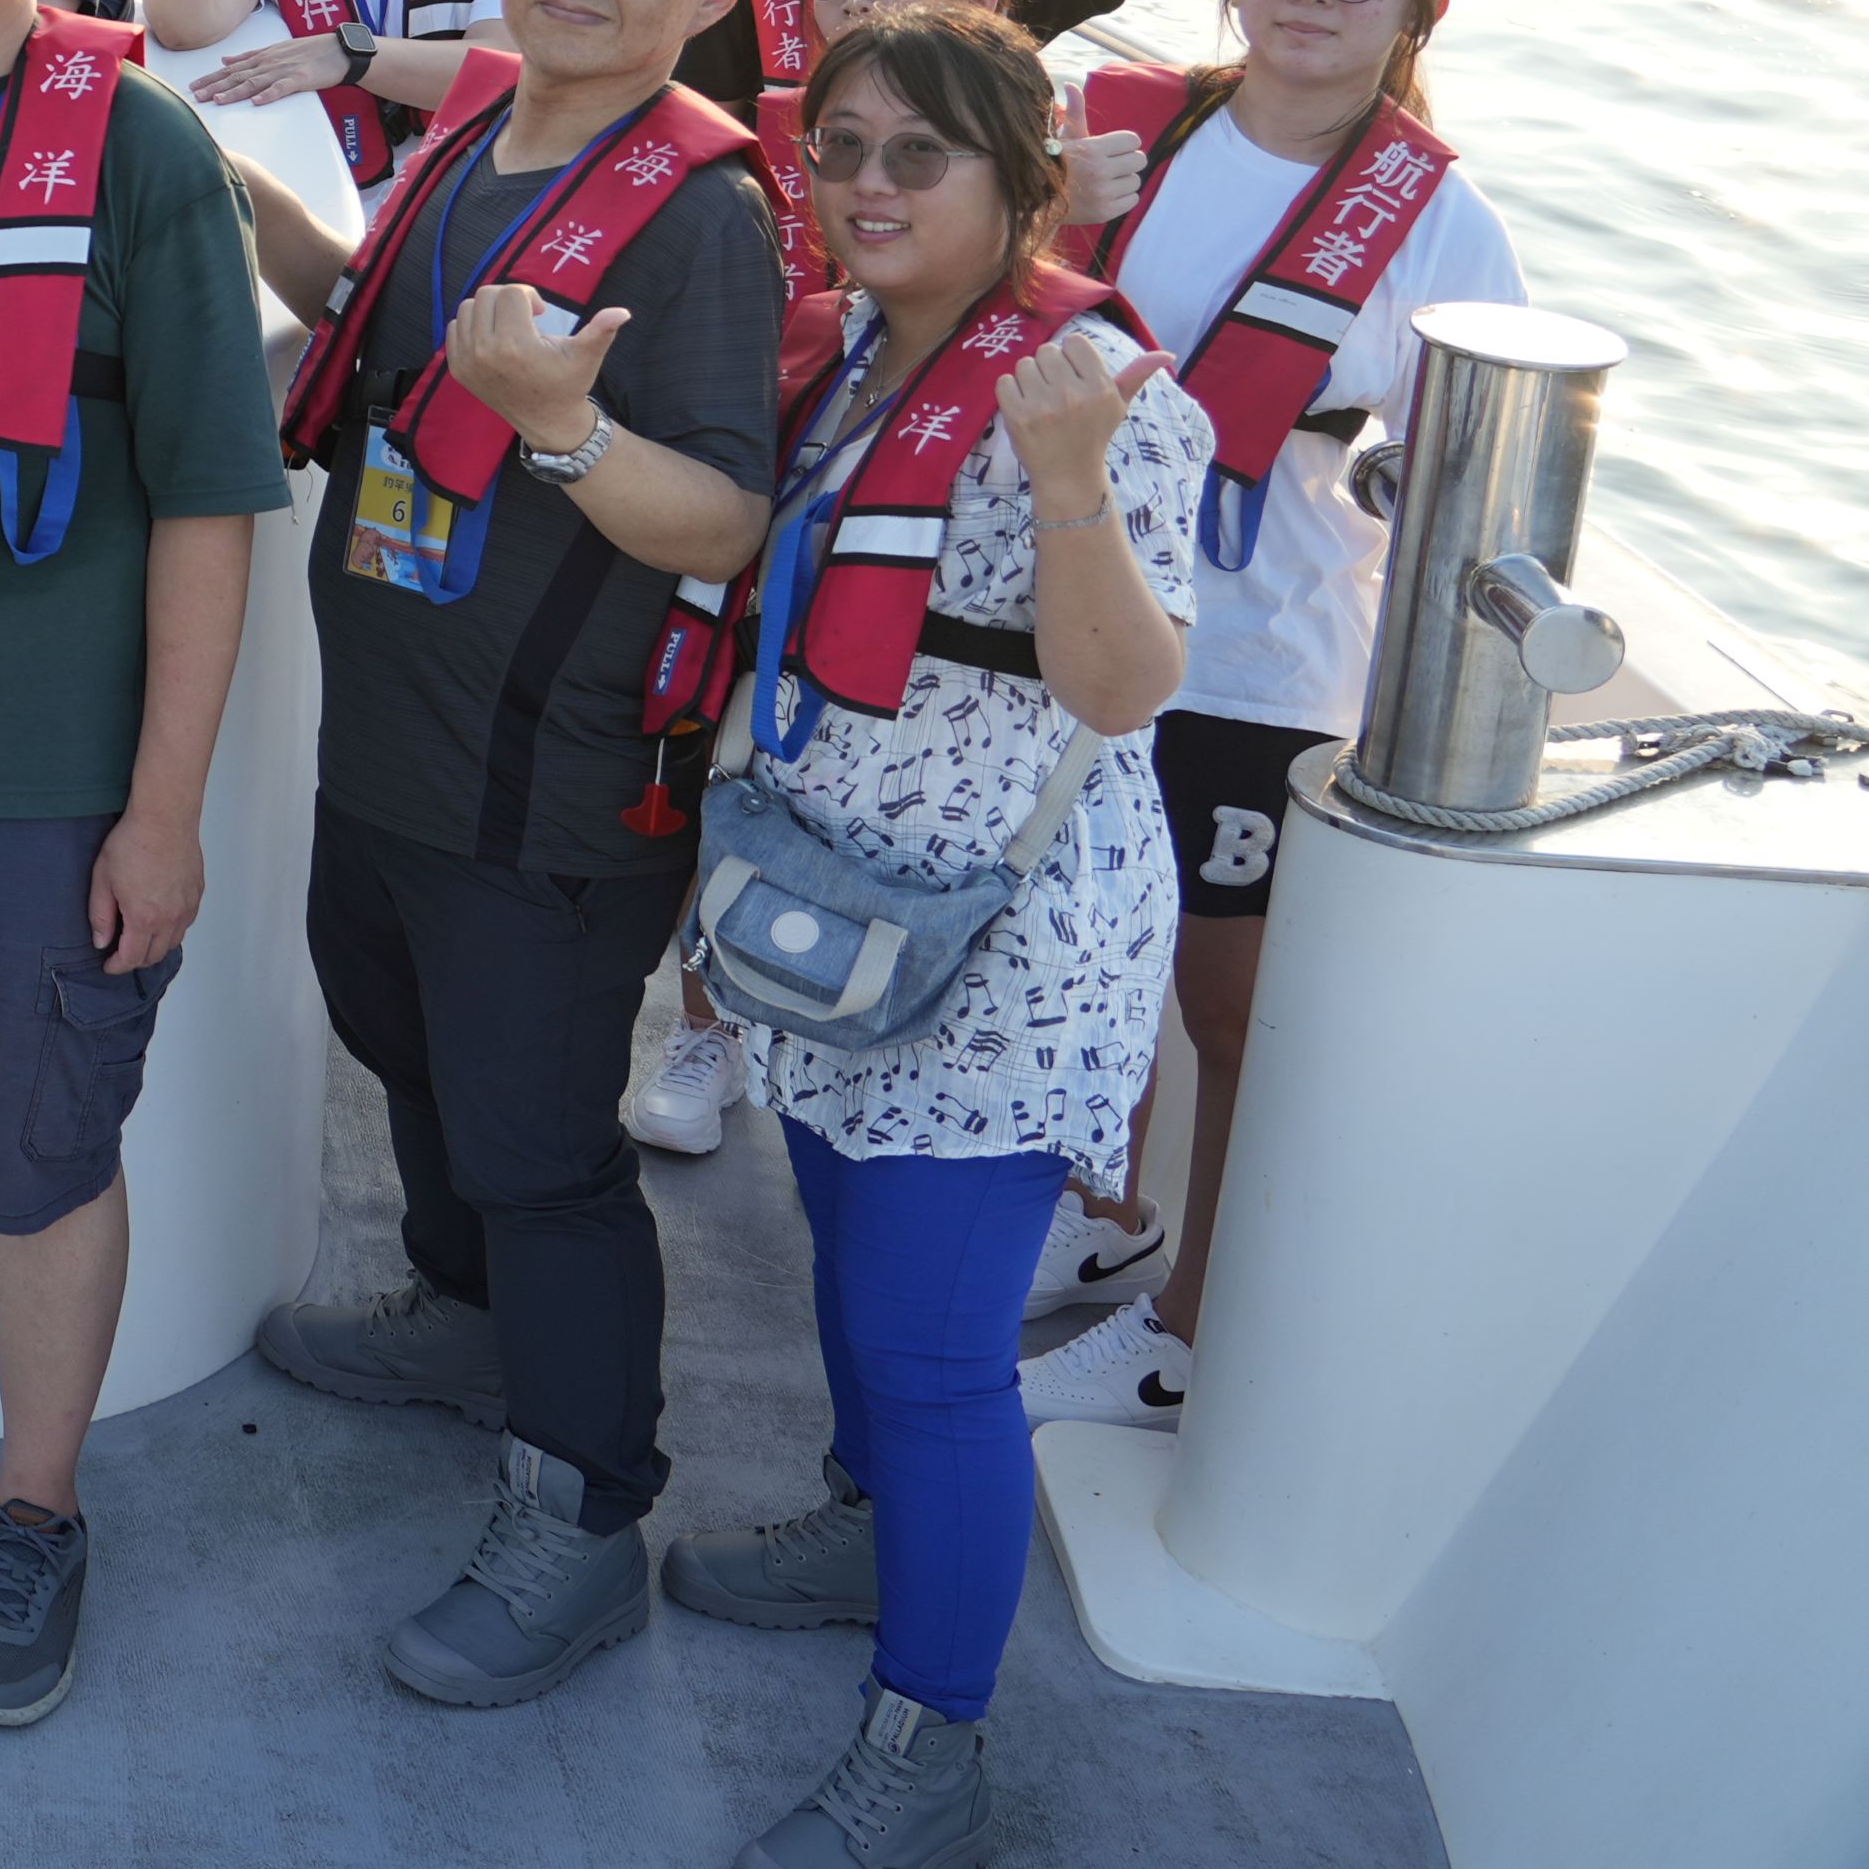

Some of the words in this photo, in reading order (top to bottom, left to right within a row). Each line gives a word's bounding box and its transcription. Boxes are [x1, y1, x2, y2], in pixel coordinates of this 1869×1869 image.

[17, 50, 103, 206] 海洋
[343, 117, 359, 151] PULL
[542, 138, 680, 275] 海洋
[1300, 140, 1434, 286] 航行者
[898, 313, 1026, 455] 海洋
[392, 500, 407, 523] 6
[657, 629, 682, 673] PULL
[1199, 806, 1276, 886] B
